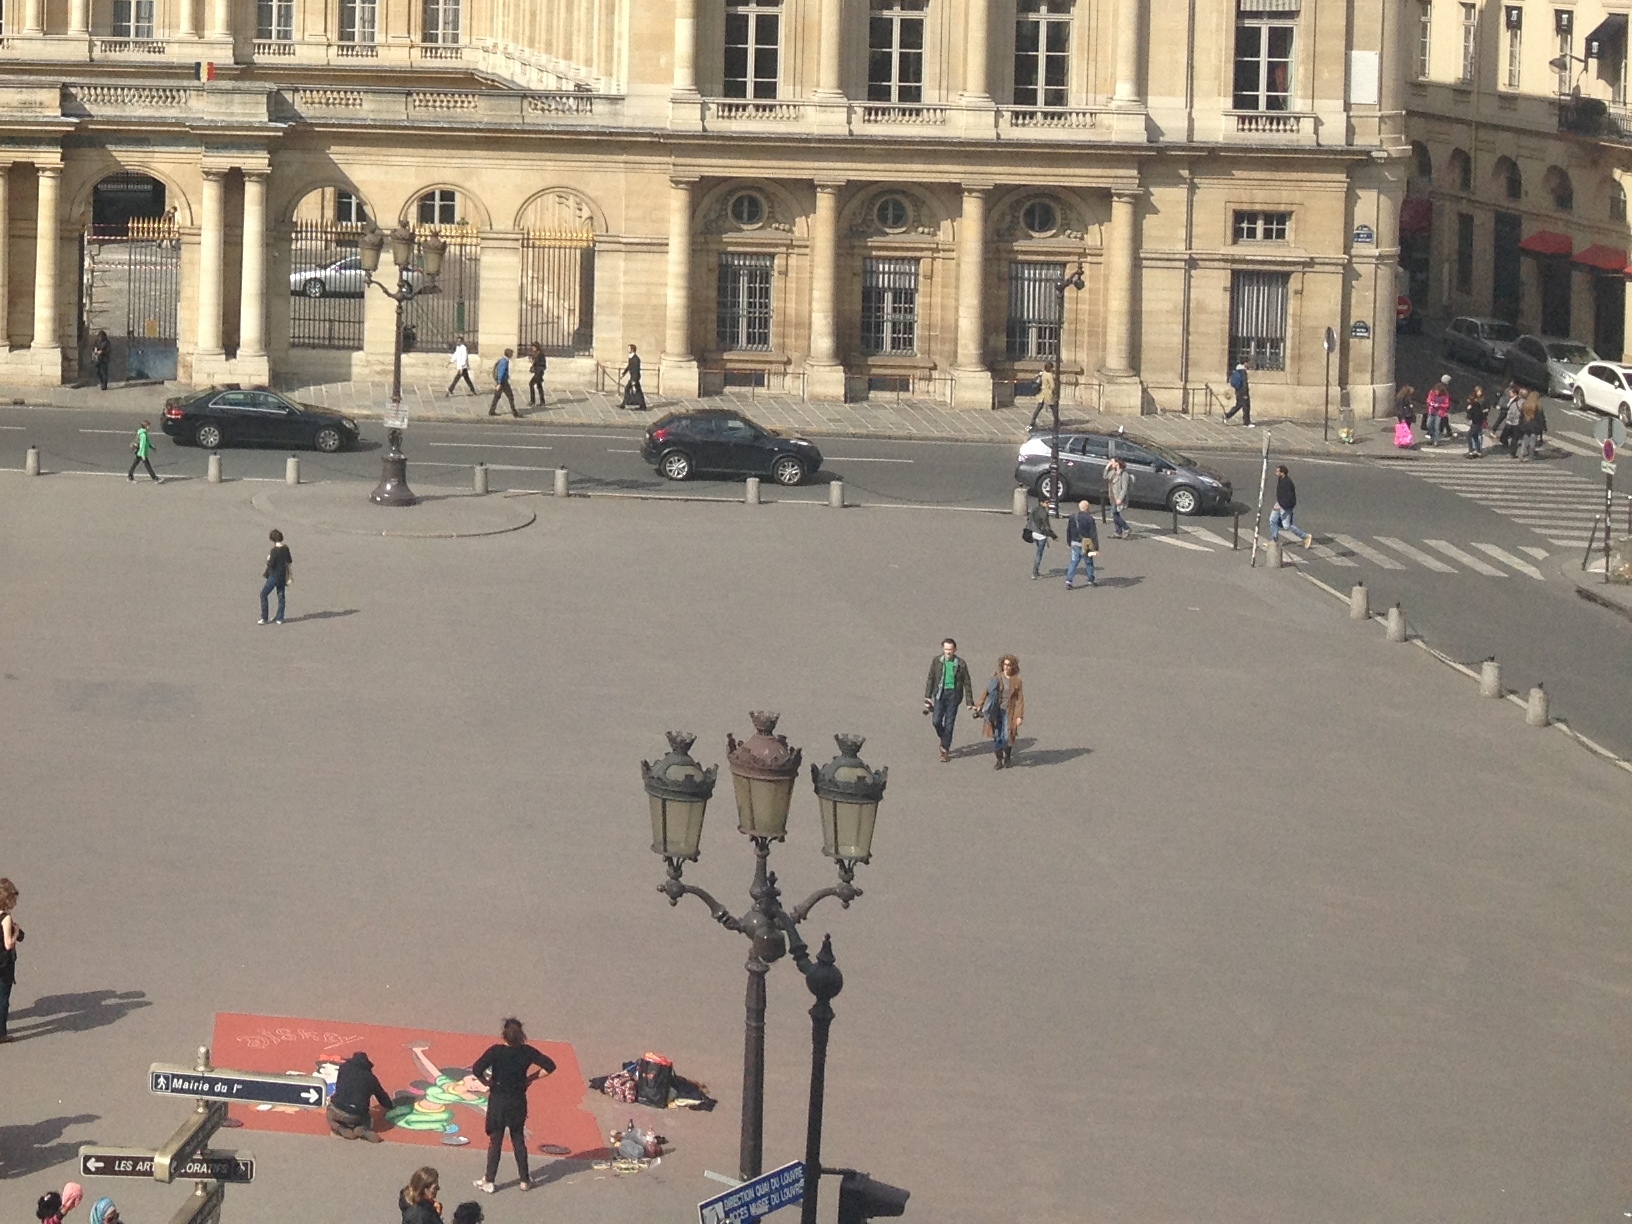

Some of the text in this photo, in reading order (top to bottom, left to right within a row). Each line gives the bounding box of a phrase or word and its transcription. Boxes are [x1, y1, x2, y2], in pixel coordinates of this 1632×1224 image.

[172, 1077, 210, 1092] Mairie
[214, 1081, 228, 1093] du
[114, 1160, 134, 1171] LES
[724, 1166, 804, 1211] DIRECTION QUAI DU LOUVRE
[771, 1192, 780, 1205] DU
[781, 1182, 804, 1201] LOUVRE
